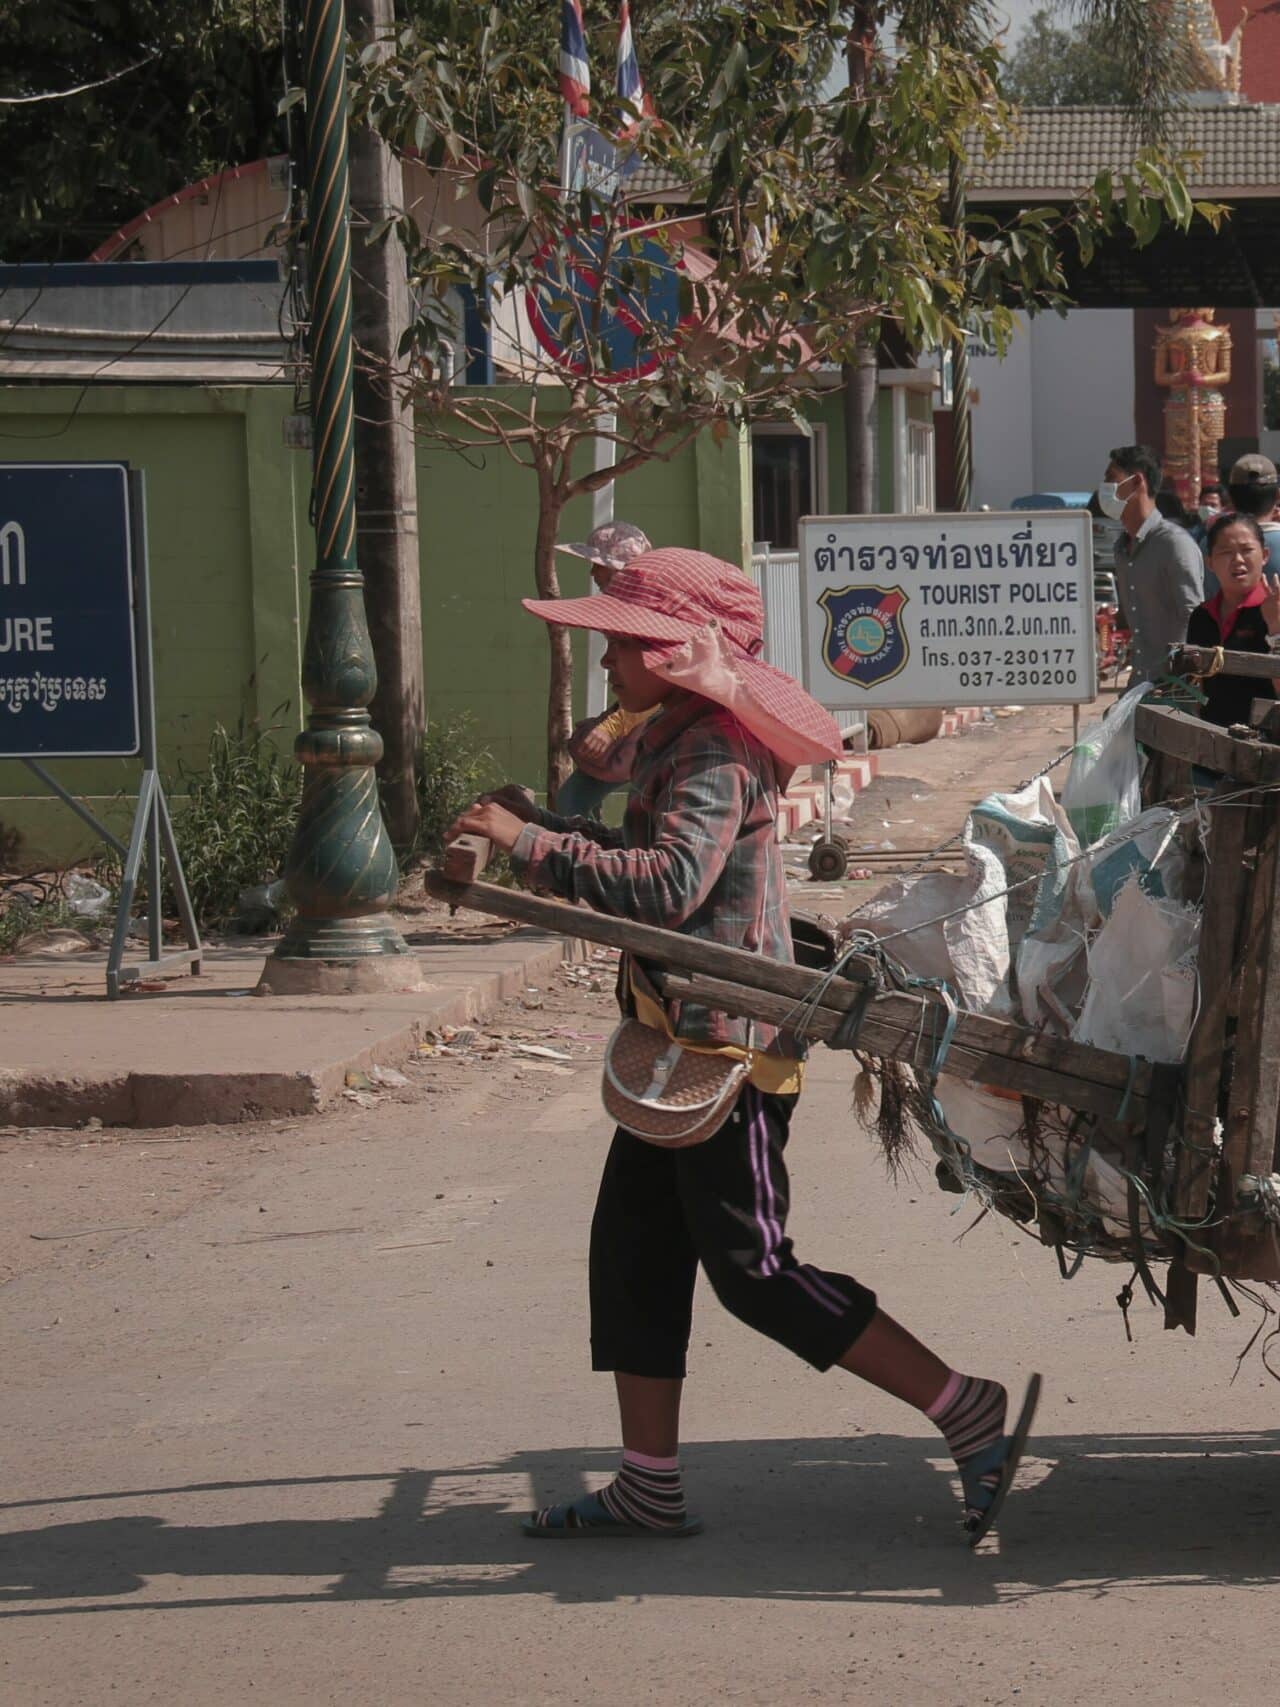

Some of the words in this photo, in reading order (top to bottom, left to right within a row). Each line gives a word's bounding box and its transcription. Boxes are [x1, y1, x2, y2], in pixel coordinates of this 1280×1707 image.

[814, 520, 1078, 572] ตำรวจท่องเที่ยว
[919, 584, 1002, 605] TOURIST
[1009, 582, 1078, 603] POLICE
[959, 670, 1077, 687] 037-230200
